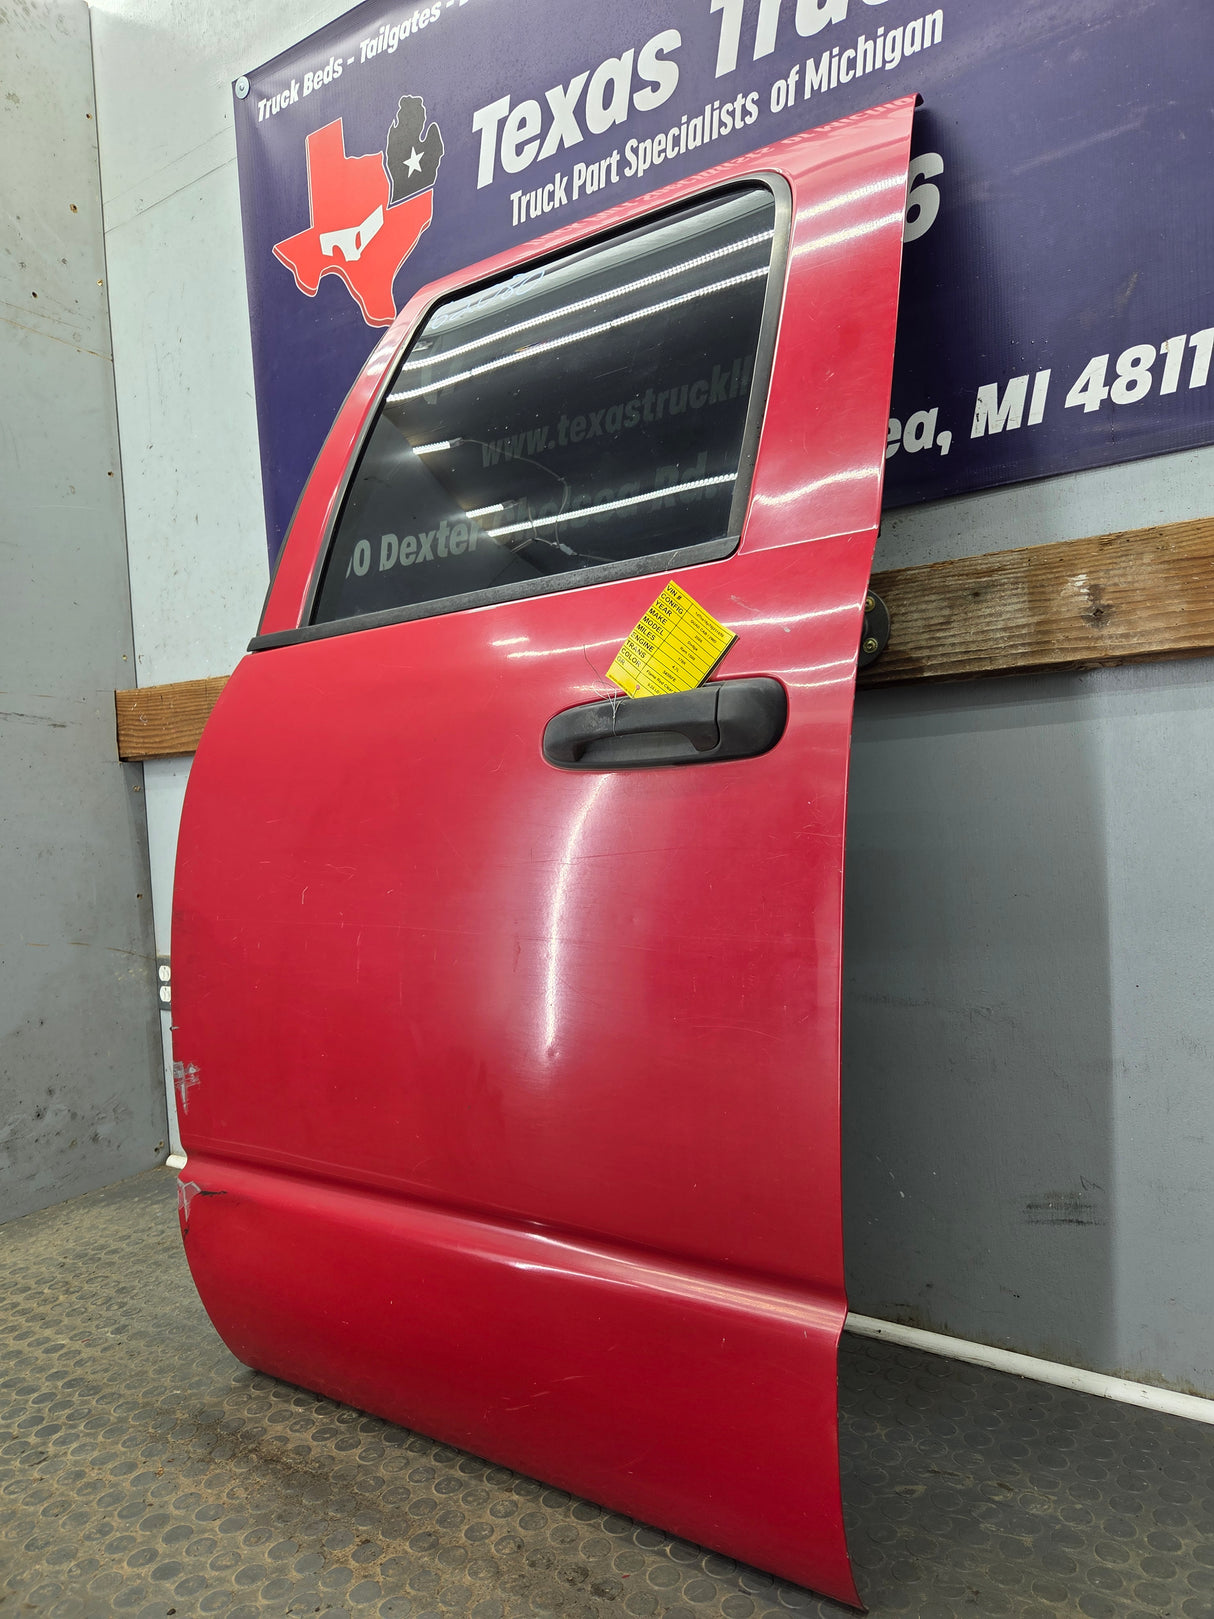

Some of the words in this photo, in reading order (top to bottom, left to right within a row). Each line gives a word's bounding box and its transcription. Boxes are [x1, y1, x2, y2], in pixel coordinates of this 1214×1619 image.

[257, 72, 301, 122] Truck
[302, 57, 343, 97] Beds
[359, 3, 442, 64] Tailgates
[472, 28, 682, 189] Texas
[510, 175, 568, 227] Truck
[572, 152, 620, 201] Part
[624, 93, 759, 178] Specialists
[770, 68, 800, 114] of
[804, 8, 944, 95] Michigan
[971, 368, 1051, 440] MI
[1064, 327, 1214, 414] 4811
[346, 538, 371, 579] 0
[379, 520, 480, 572] Dexter
[666, 585, 677, 598] VIN
[655, 600, 672, 617] YEAR
[660, 593, 684, 615] CONFIG
[642, 615, 664, 636] MODEL
[648, 608, 668, 626] MAKE
[630, 631, 655, 653] ENGINE
[636, 623, 656, 641] MILES
[620, 648, 642, 668] COLOR
[625, 640, 646, 659] TRANS
[616, 656, 625, 666] GR
